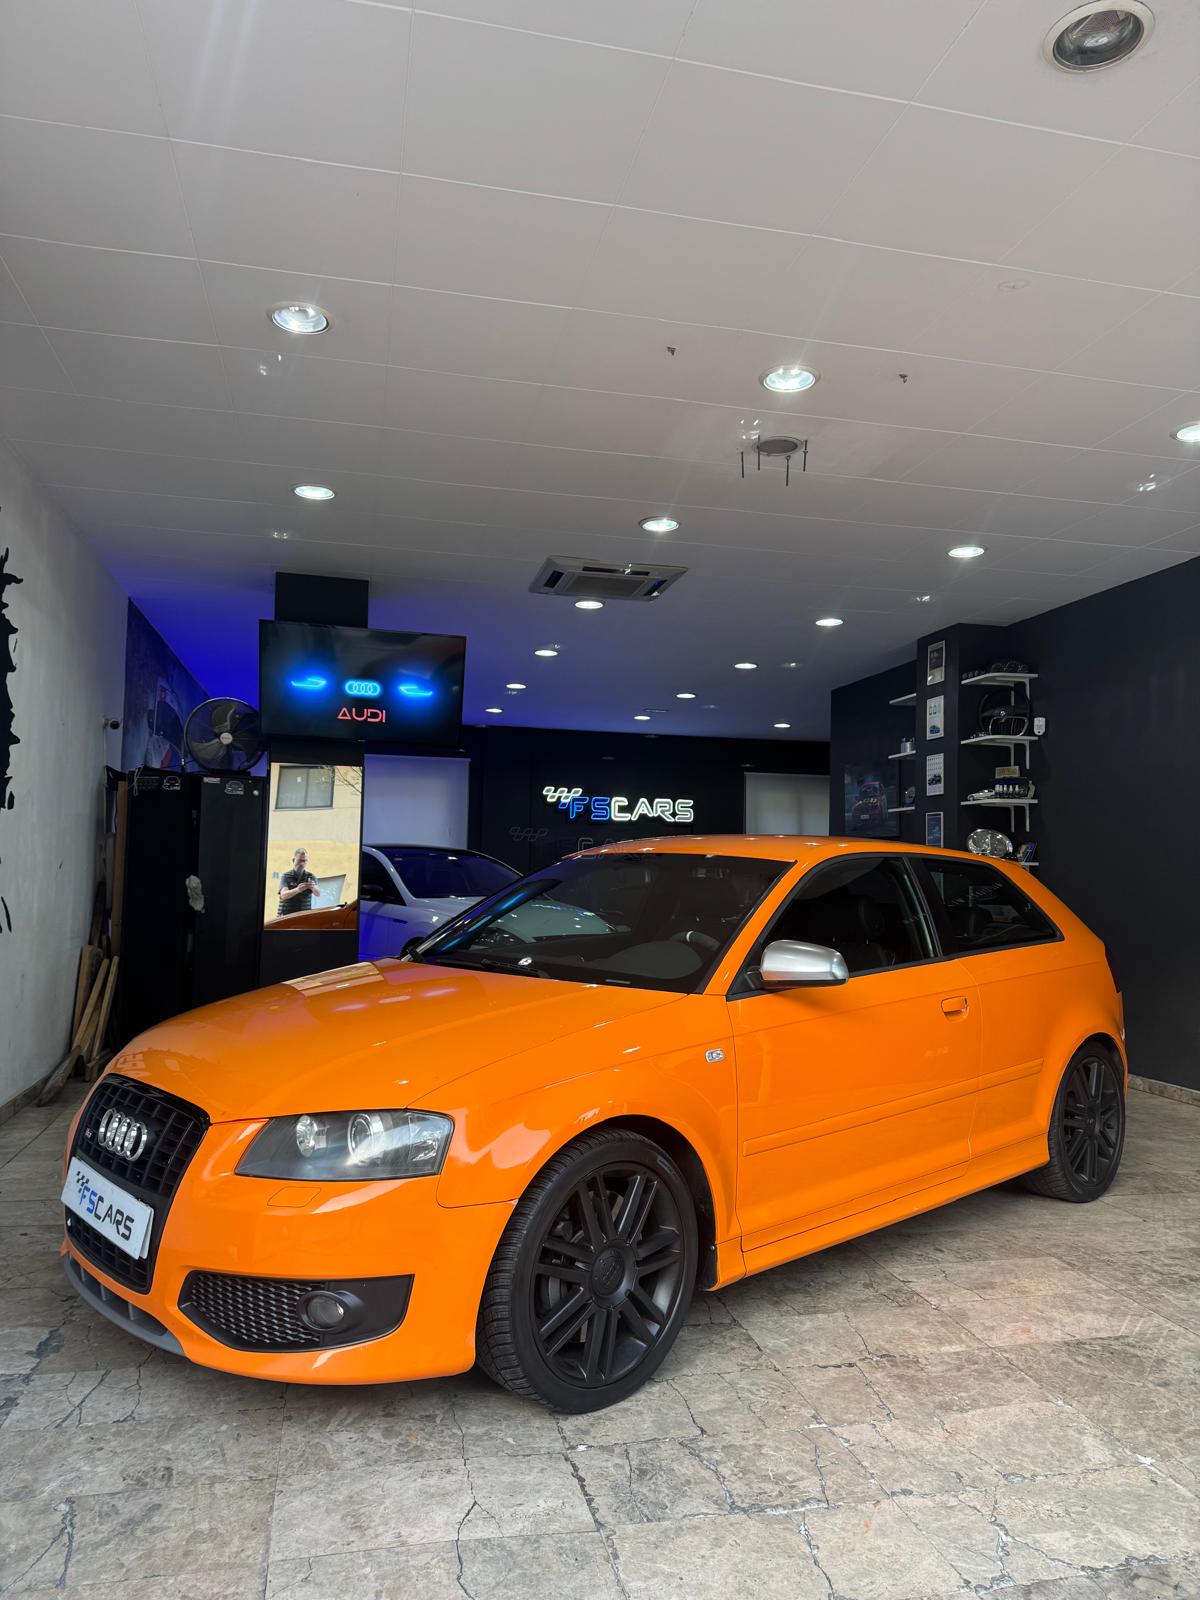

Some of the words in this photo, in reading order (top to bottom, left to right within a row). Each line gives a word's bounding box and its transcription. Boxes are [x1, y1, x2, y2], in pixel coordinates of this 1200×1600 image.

[337, 707, 386, 723] AUDI
[569, 796, 694, 822] FSCARS
[79, 1186, 135, 1241] FSCARS
